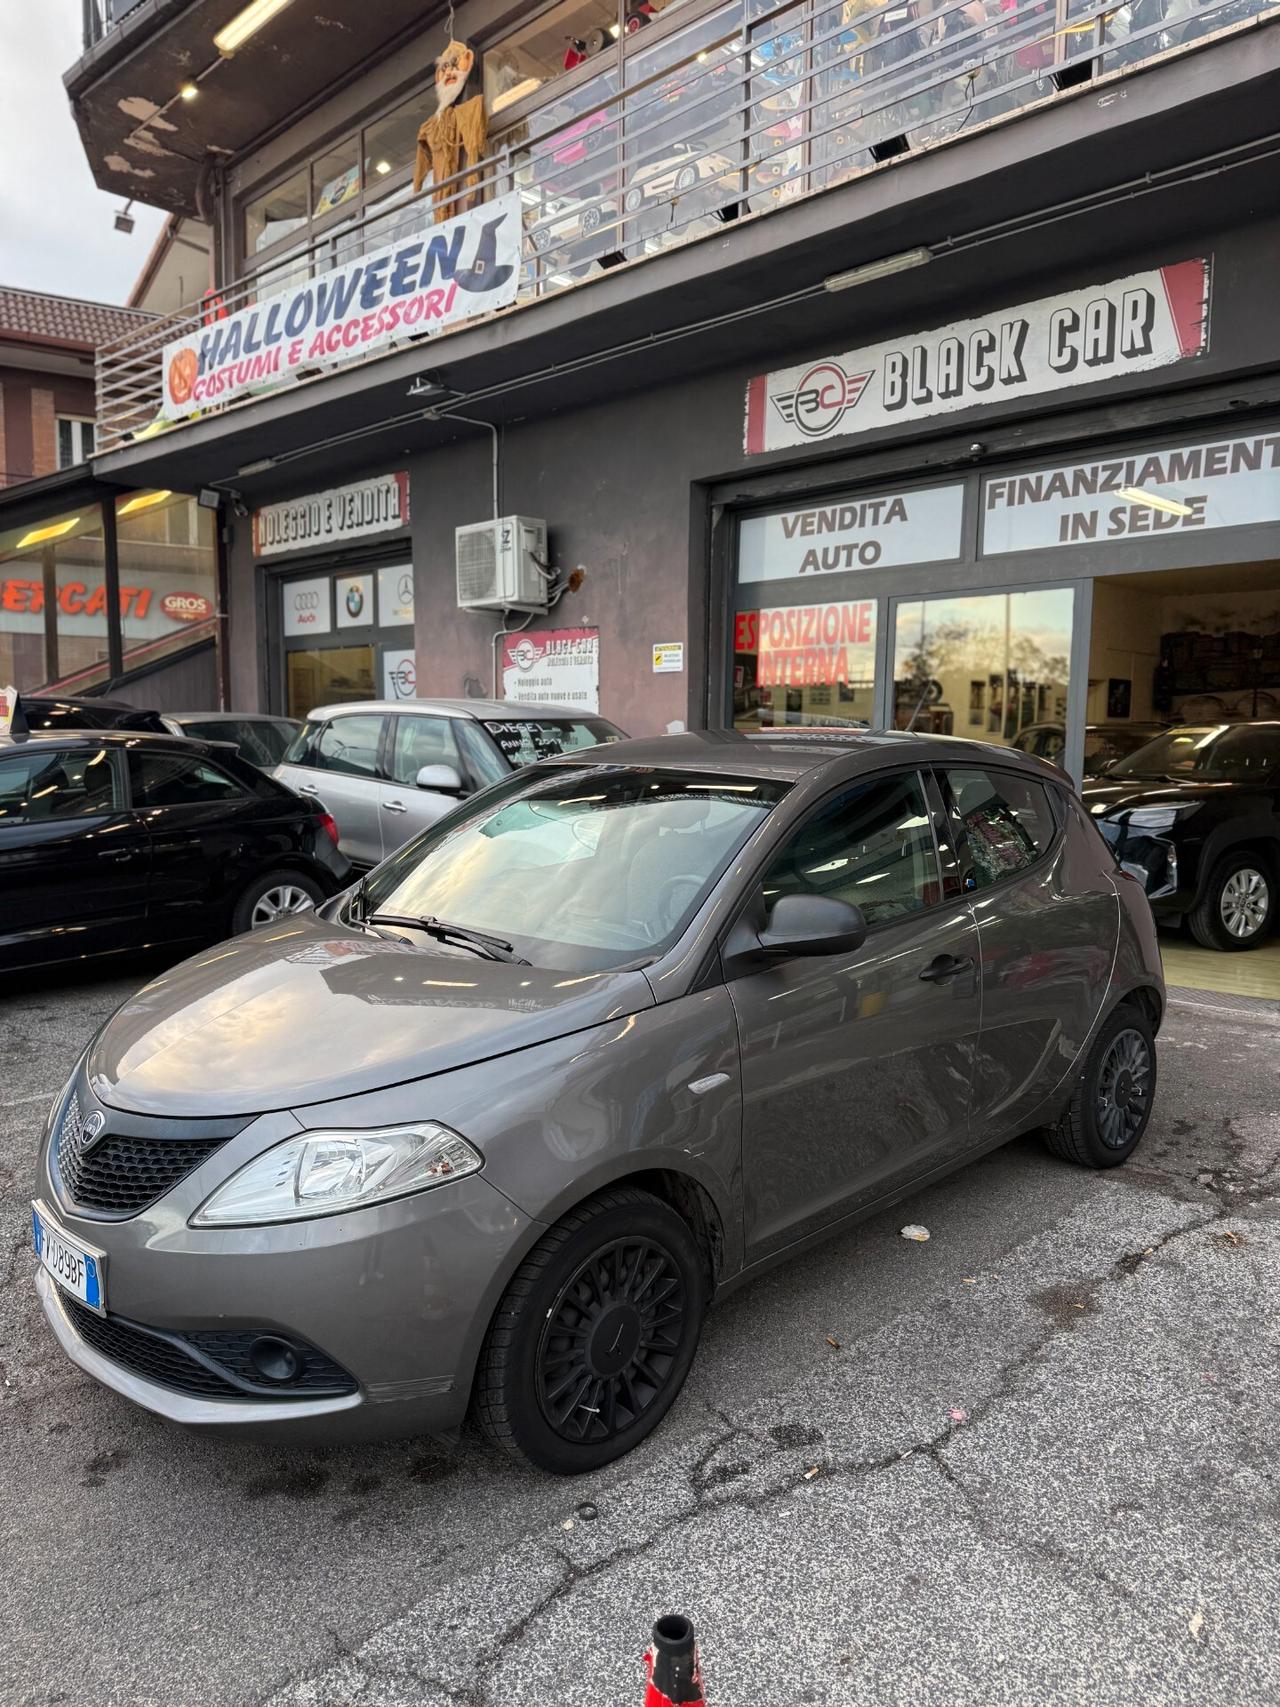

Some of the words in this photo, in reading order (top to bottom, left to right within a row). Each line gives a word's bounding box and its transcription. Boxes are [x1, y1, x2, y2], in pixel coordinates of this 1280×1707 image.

[197, 225, 467, 376] HALLOWEEN
[193, 345, 282, 401] COSTUMI
[288, 339, 304, 367] E
[307, 282, 458, 359] ACCESSORI
[882, 318, 1030, 412] BLACK
[1047, 287, 1156, 374] CAR
[323, 499, 333, 533] E
[336, 481, 401, 531] VENDITA
[781, 497, 908, 540] VENDITA
[1059, 510, 1099, 543] IN
[1107, 495, 1208, 536] SEDE
[798, 540, 883, 574] AUTO
[164, 596, 206, 611] GROS
[297, 613, 316, 624] Audi
[735, 602, 873, 652] ESPOSIZIONE
[756, 647, 849, 690] INTERNA
[484, 720, 561, 734] DIESEL
